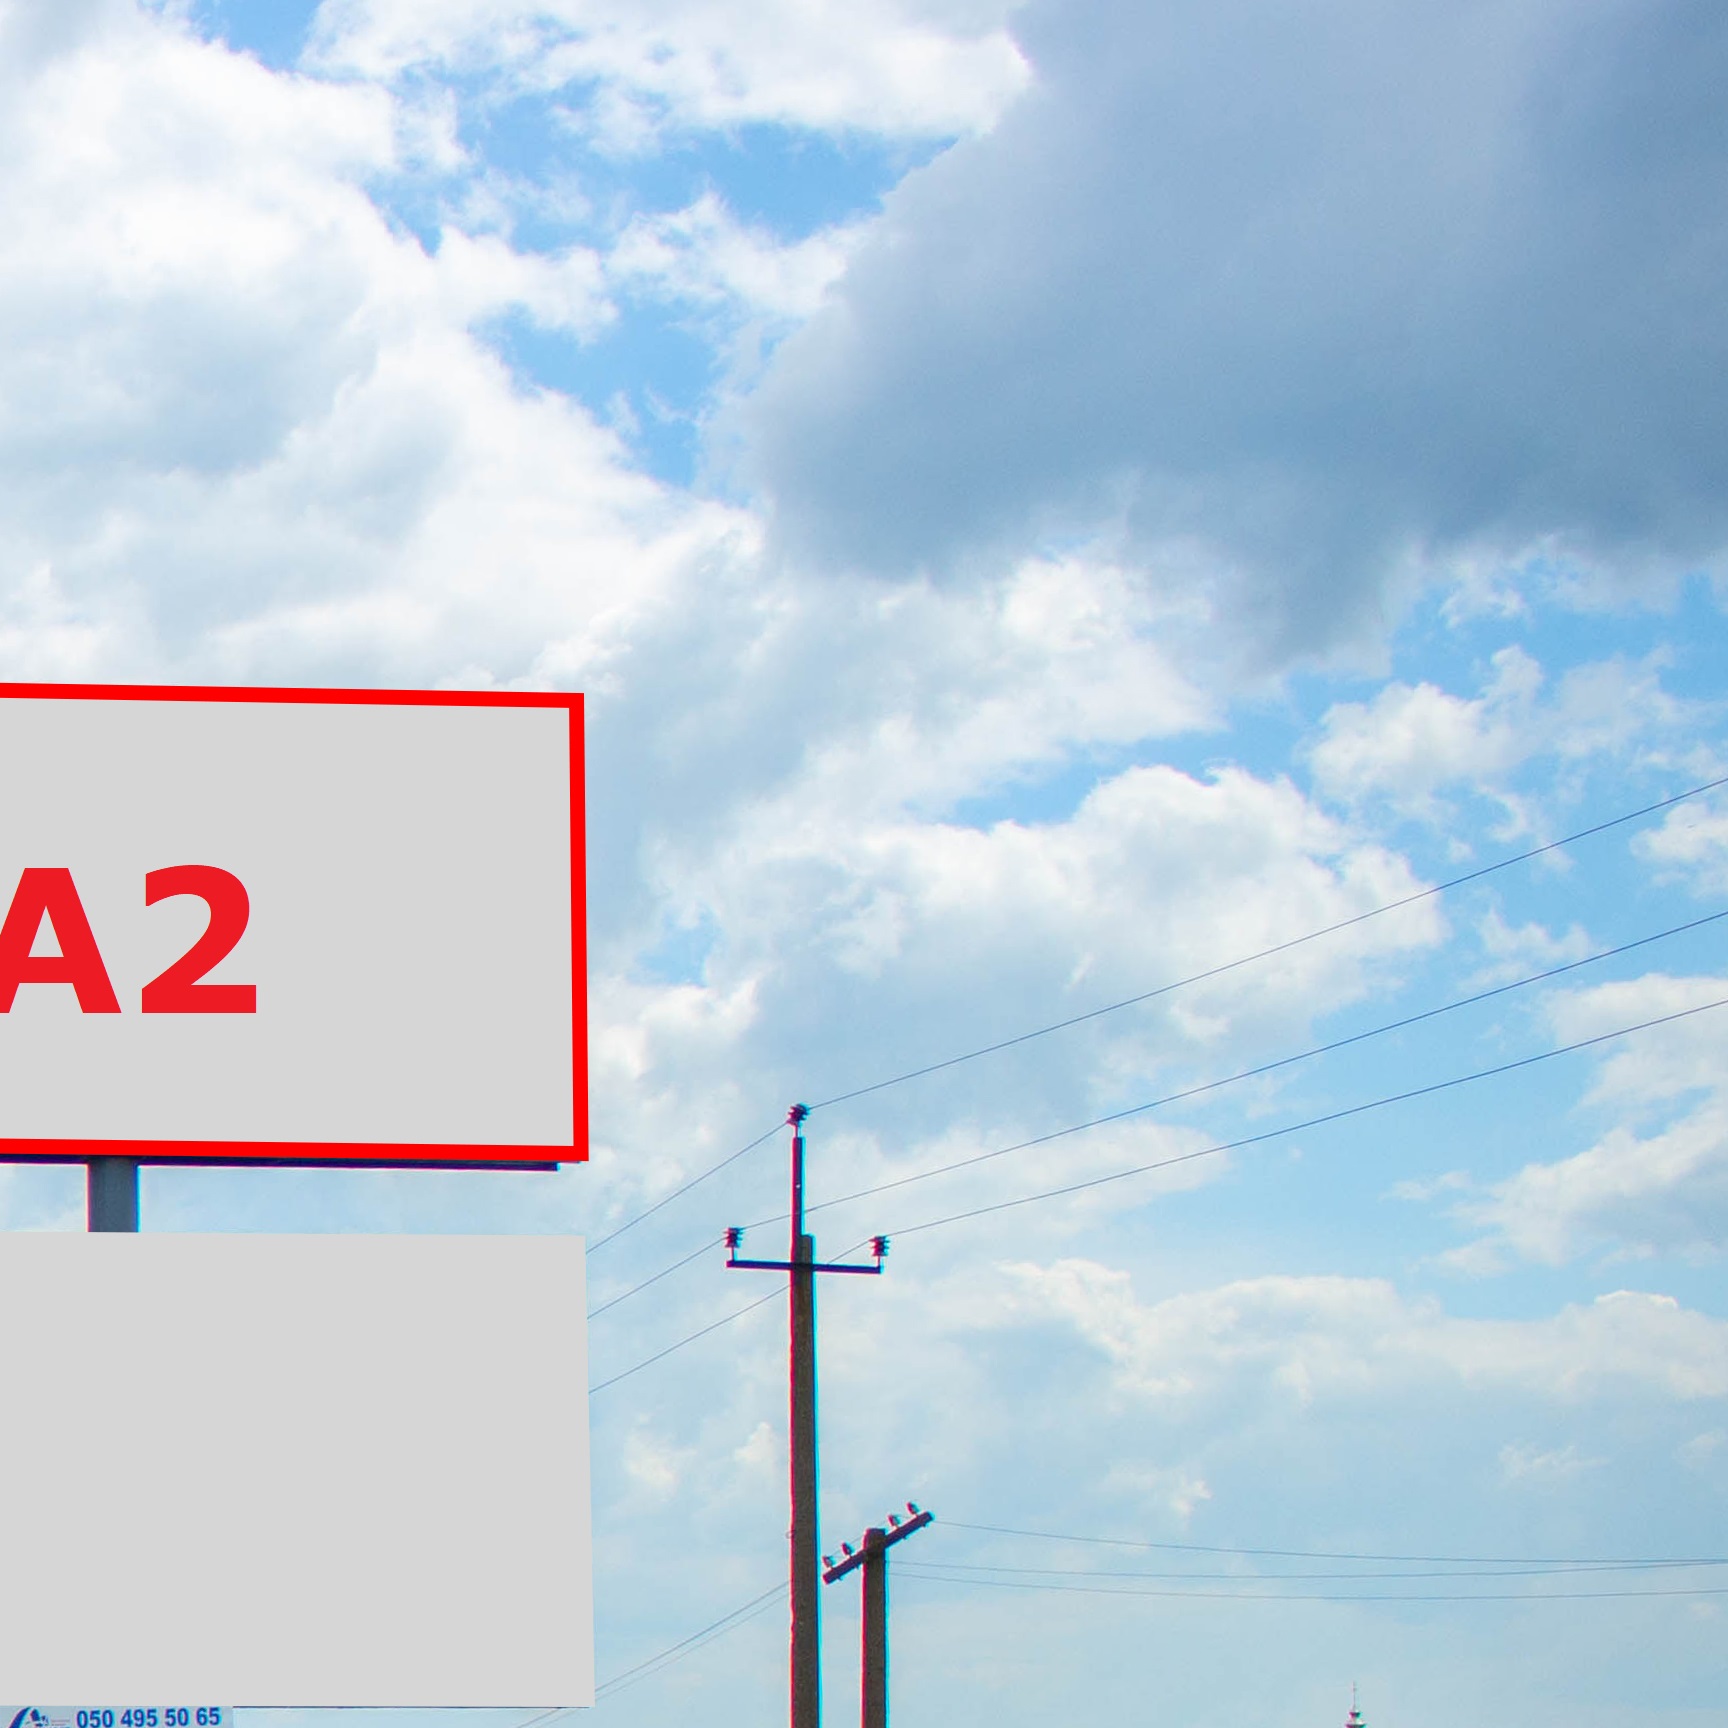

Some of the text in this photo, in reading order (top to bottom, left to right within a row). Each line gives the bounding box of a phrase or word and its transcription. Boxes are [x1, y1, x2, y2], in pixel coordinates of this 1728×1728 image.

[77, 1707, 221, 1728] 050 495 50 65
